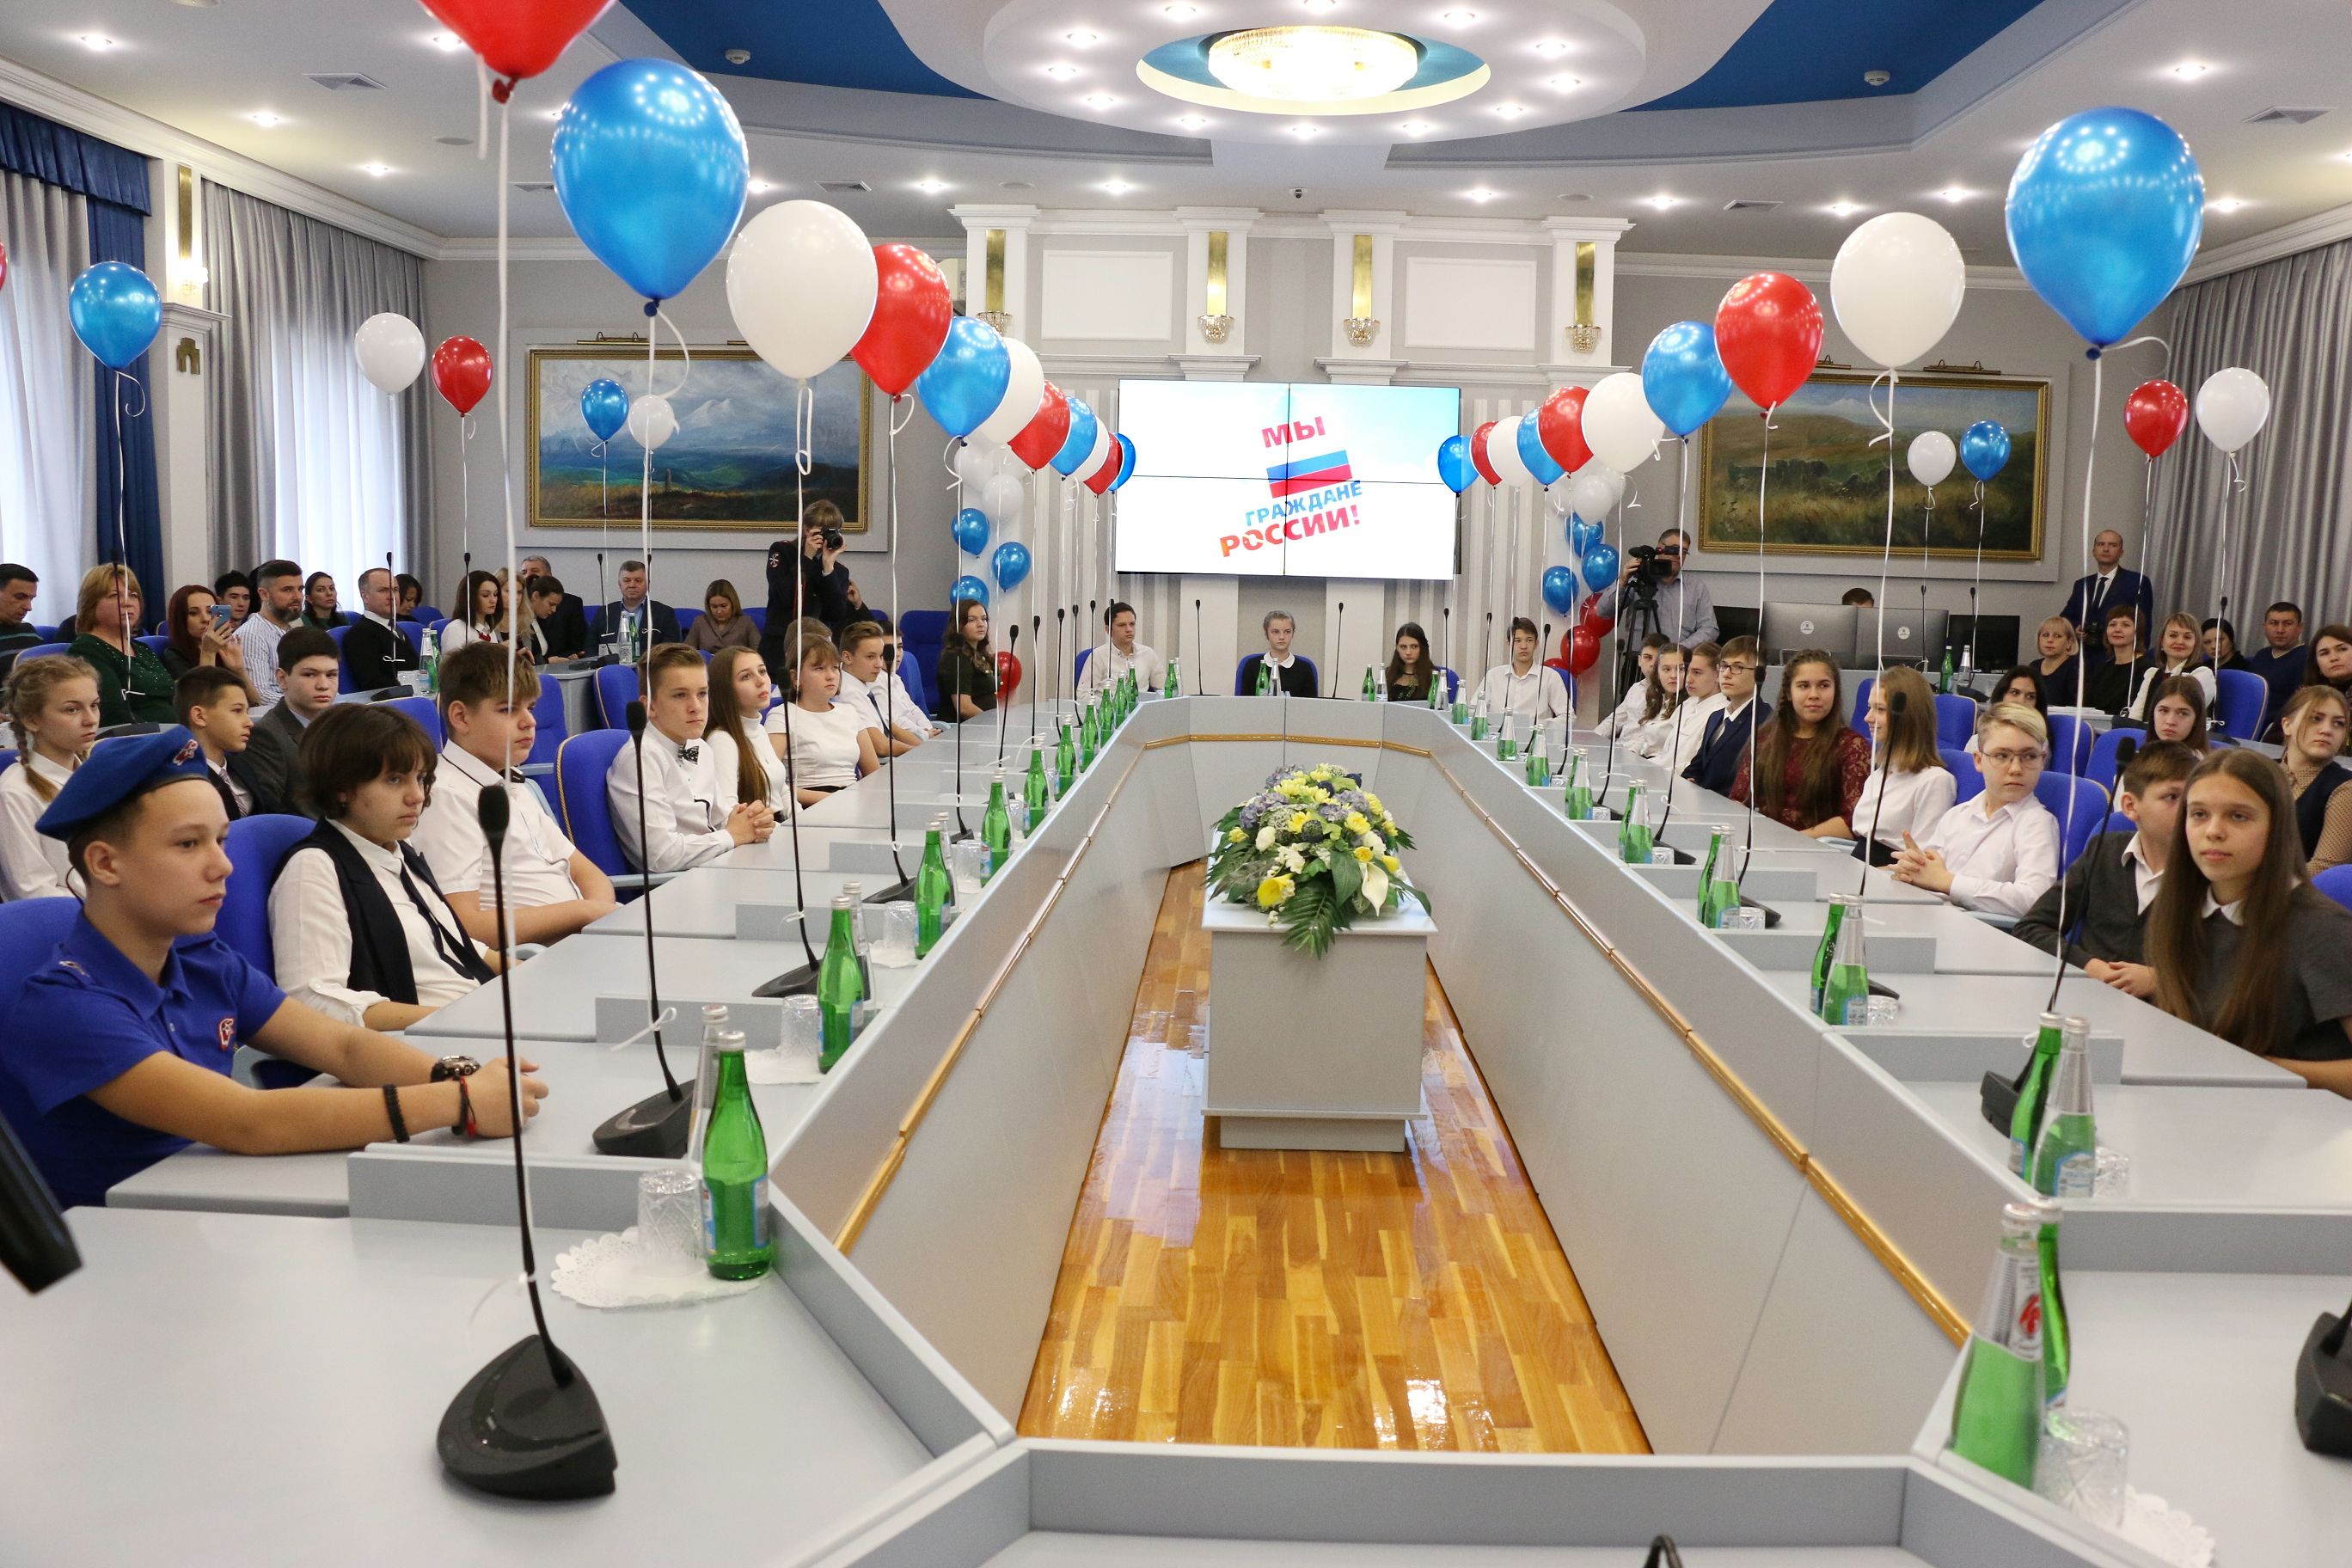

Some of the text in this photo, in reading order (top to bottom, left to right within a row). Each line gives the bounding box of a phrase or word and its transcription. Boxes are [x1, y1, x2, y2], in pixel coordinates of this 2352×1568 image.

[1262, 417, 1326, 448] МЫ
[1246, 481, 1363, 526] ГРАЖДАНЕ
[1220, 505, 1360, 557] РОССИИ!
